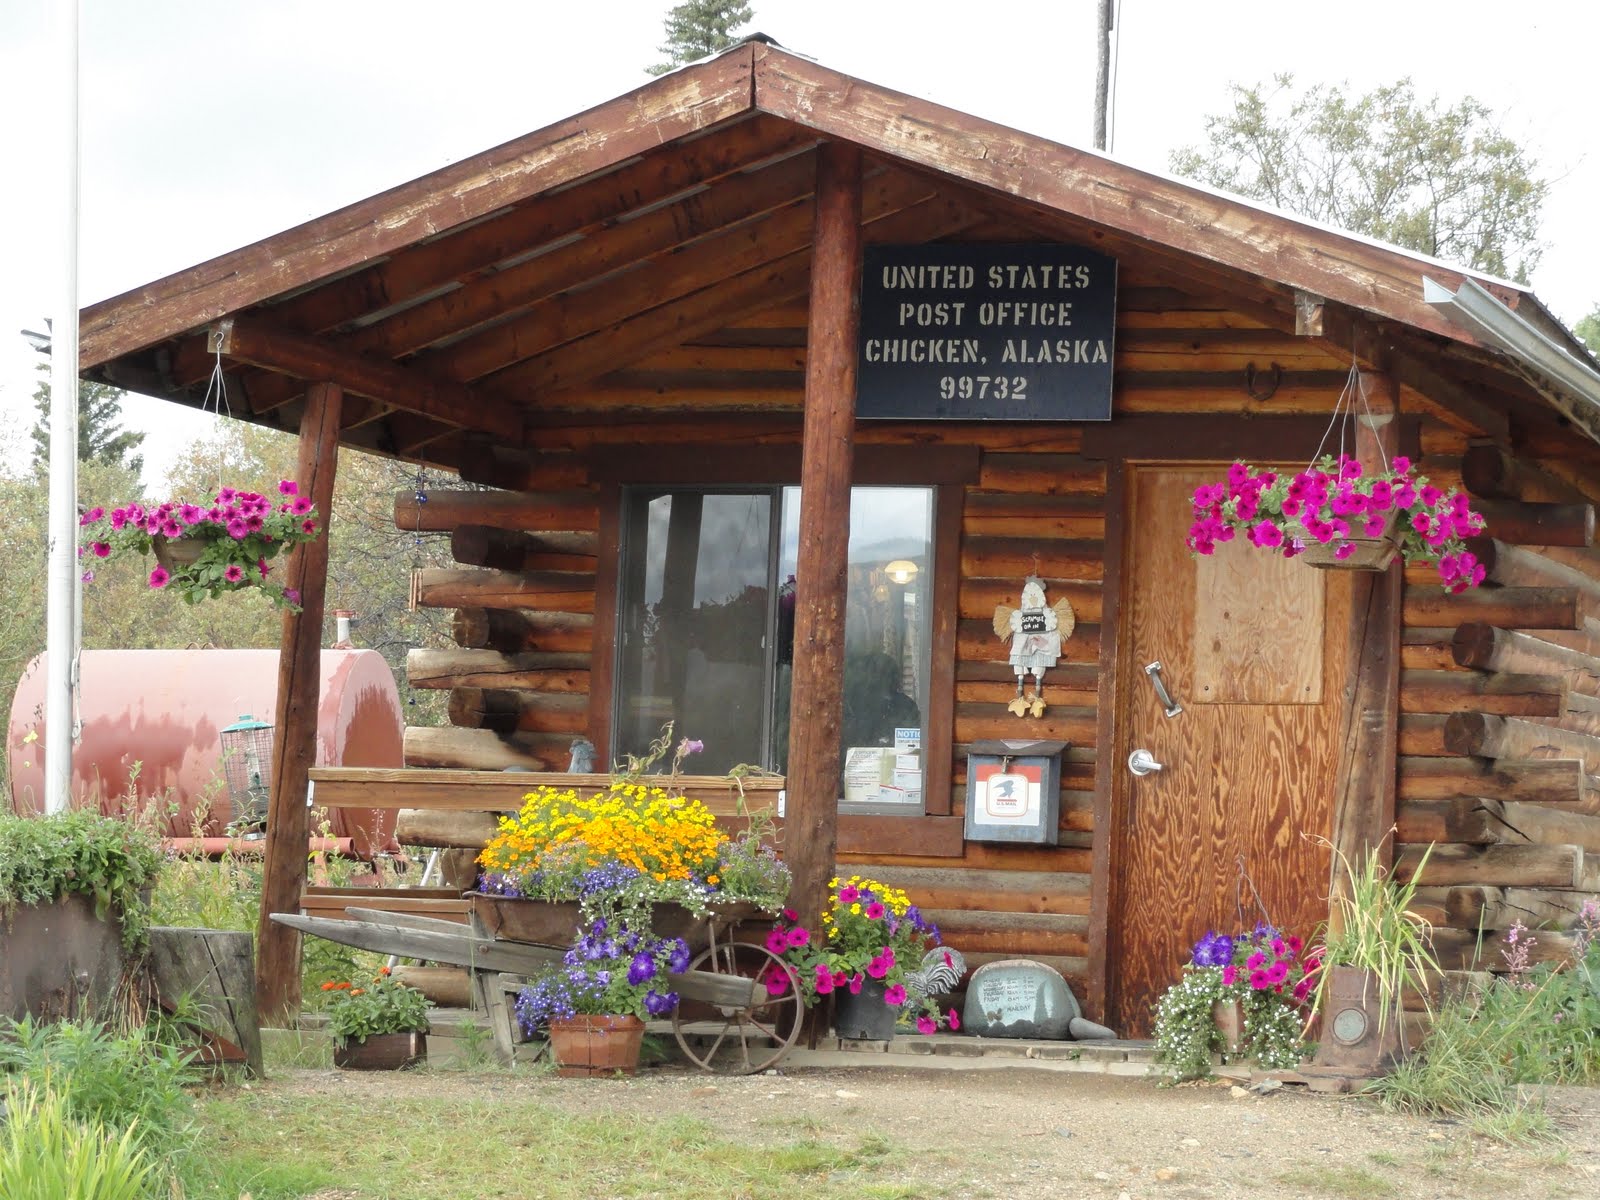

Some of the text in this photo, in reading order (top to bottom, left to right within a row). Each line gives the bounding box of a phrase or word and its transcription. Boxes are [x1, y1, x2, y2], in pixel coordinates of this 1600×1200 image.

[882, 265, 1090, 289] UNITED STATES
[899, 302, 1073, 326] POST OFFICE
[865, 339, 1108, 365] CHICKEN, ALASKA
[940, 376, 1028, 400] 99732
